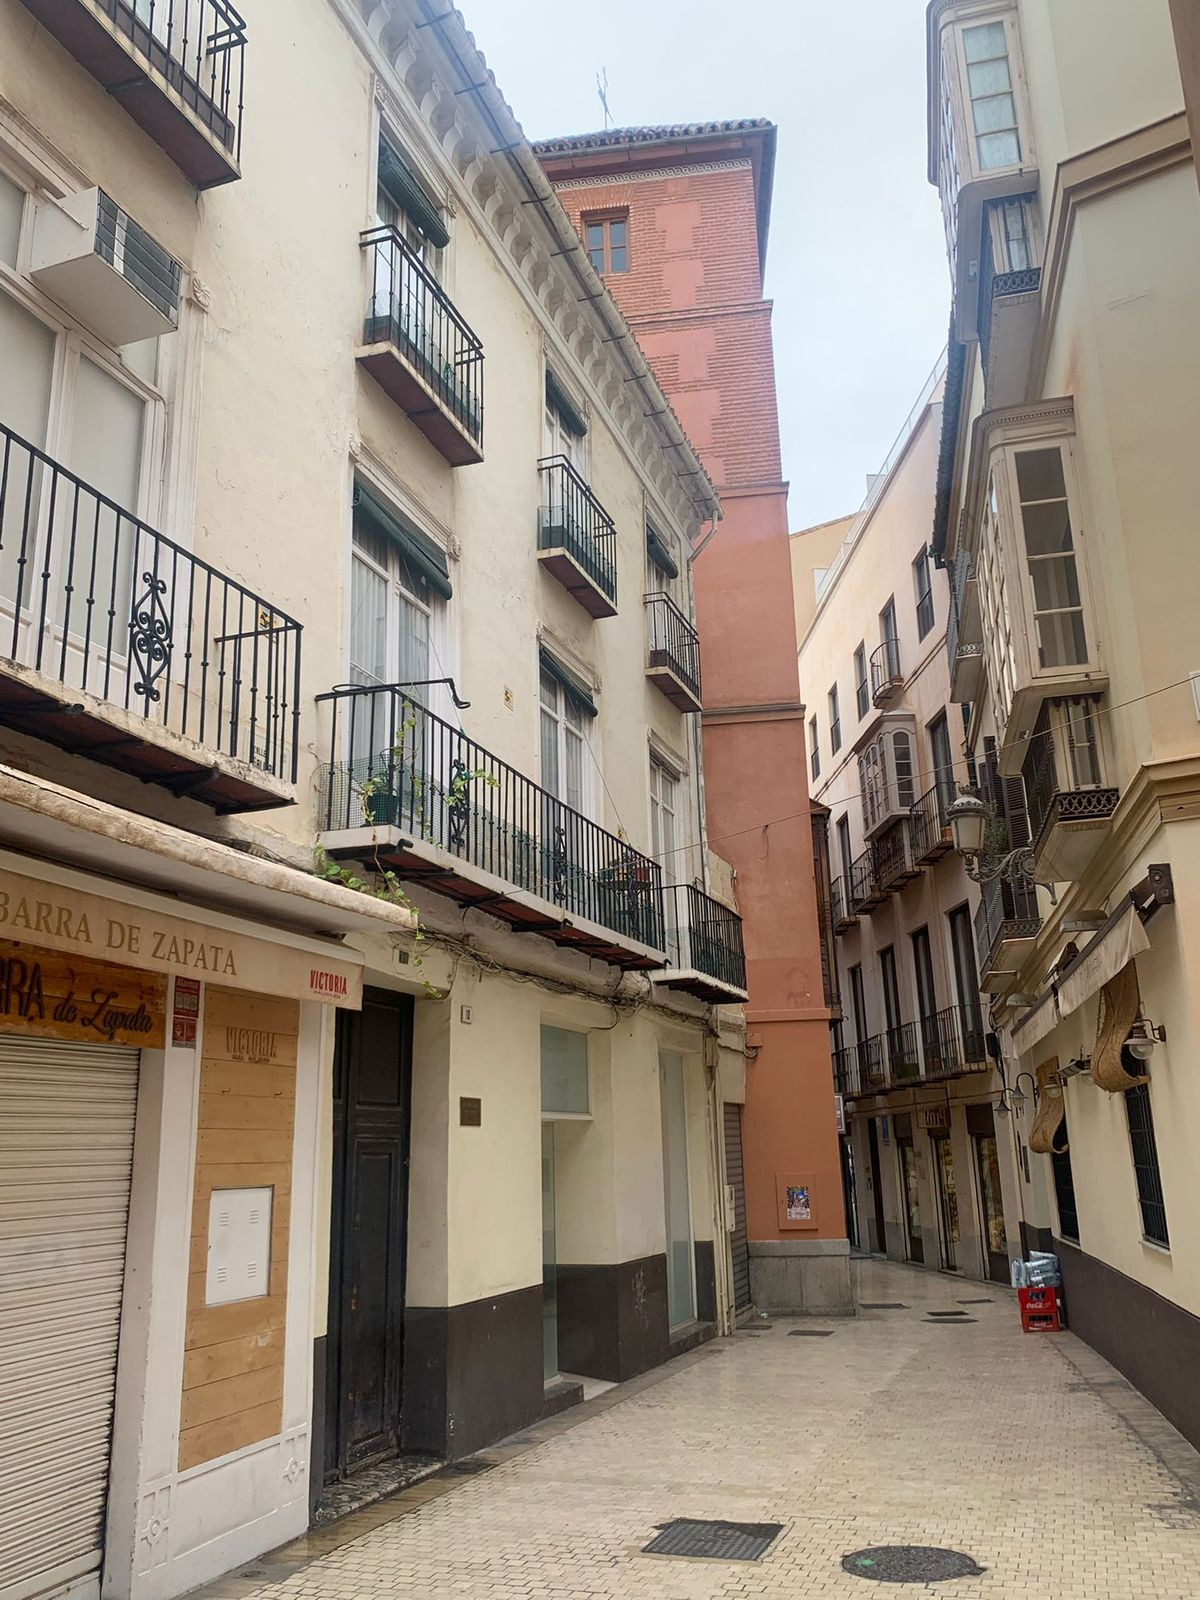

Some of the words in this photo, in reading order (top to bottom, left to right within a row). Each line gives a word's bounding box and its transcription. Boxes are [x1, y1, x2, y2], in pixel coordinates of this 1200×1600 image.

[106, 919, 141, 954] DE
[152, 931, 237, 976] ZAPATA
[310, 969, 347, 995] VICTORIA
[53, 991, 78, 1023] de
[81, 988, 153, 1040] Zapata
[226, 1026, 276, 1058] VICTORIA
